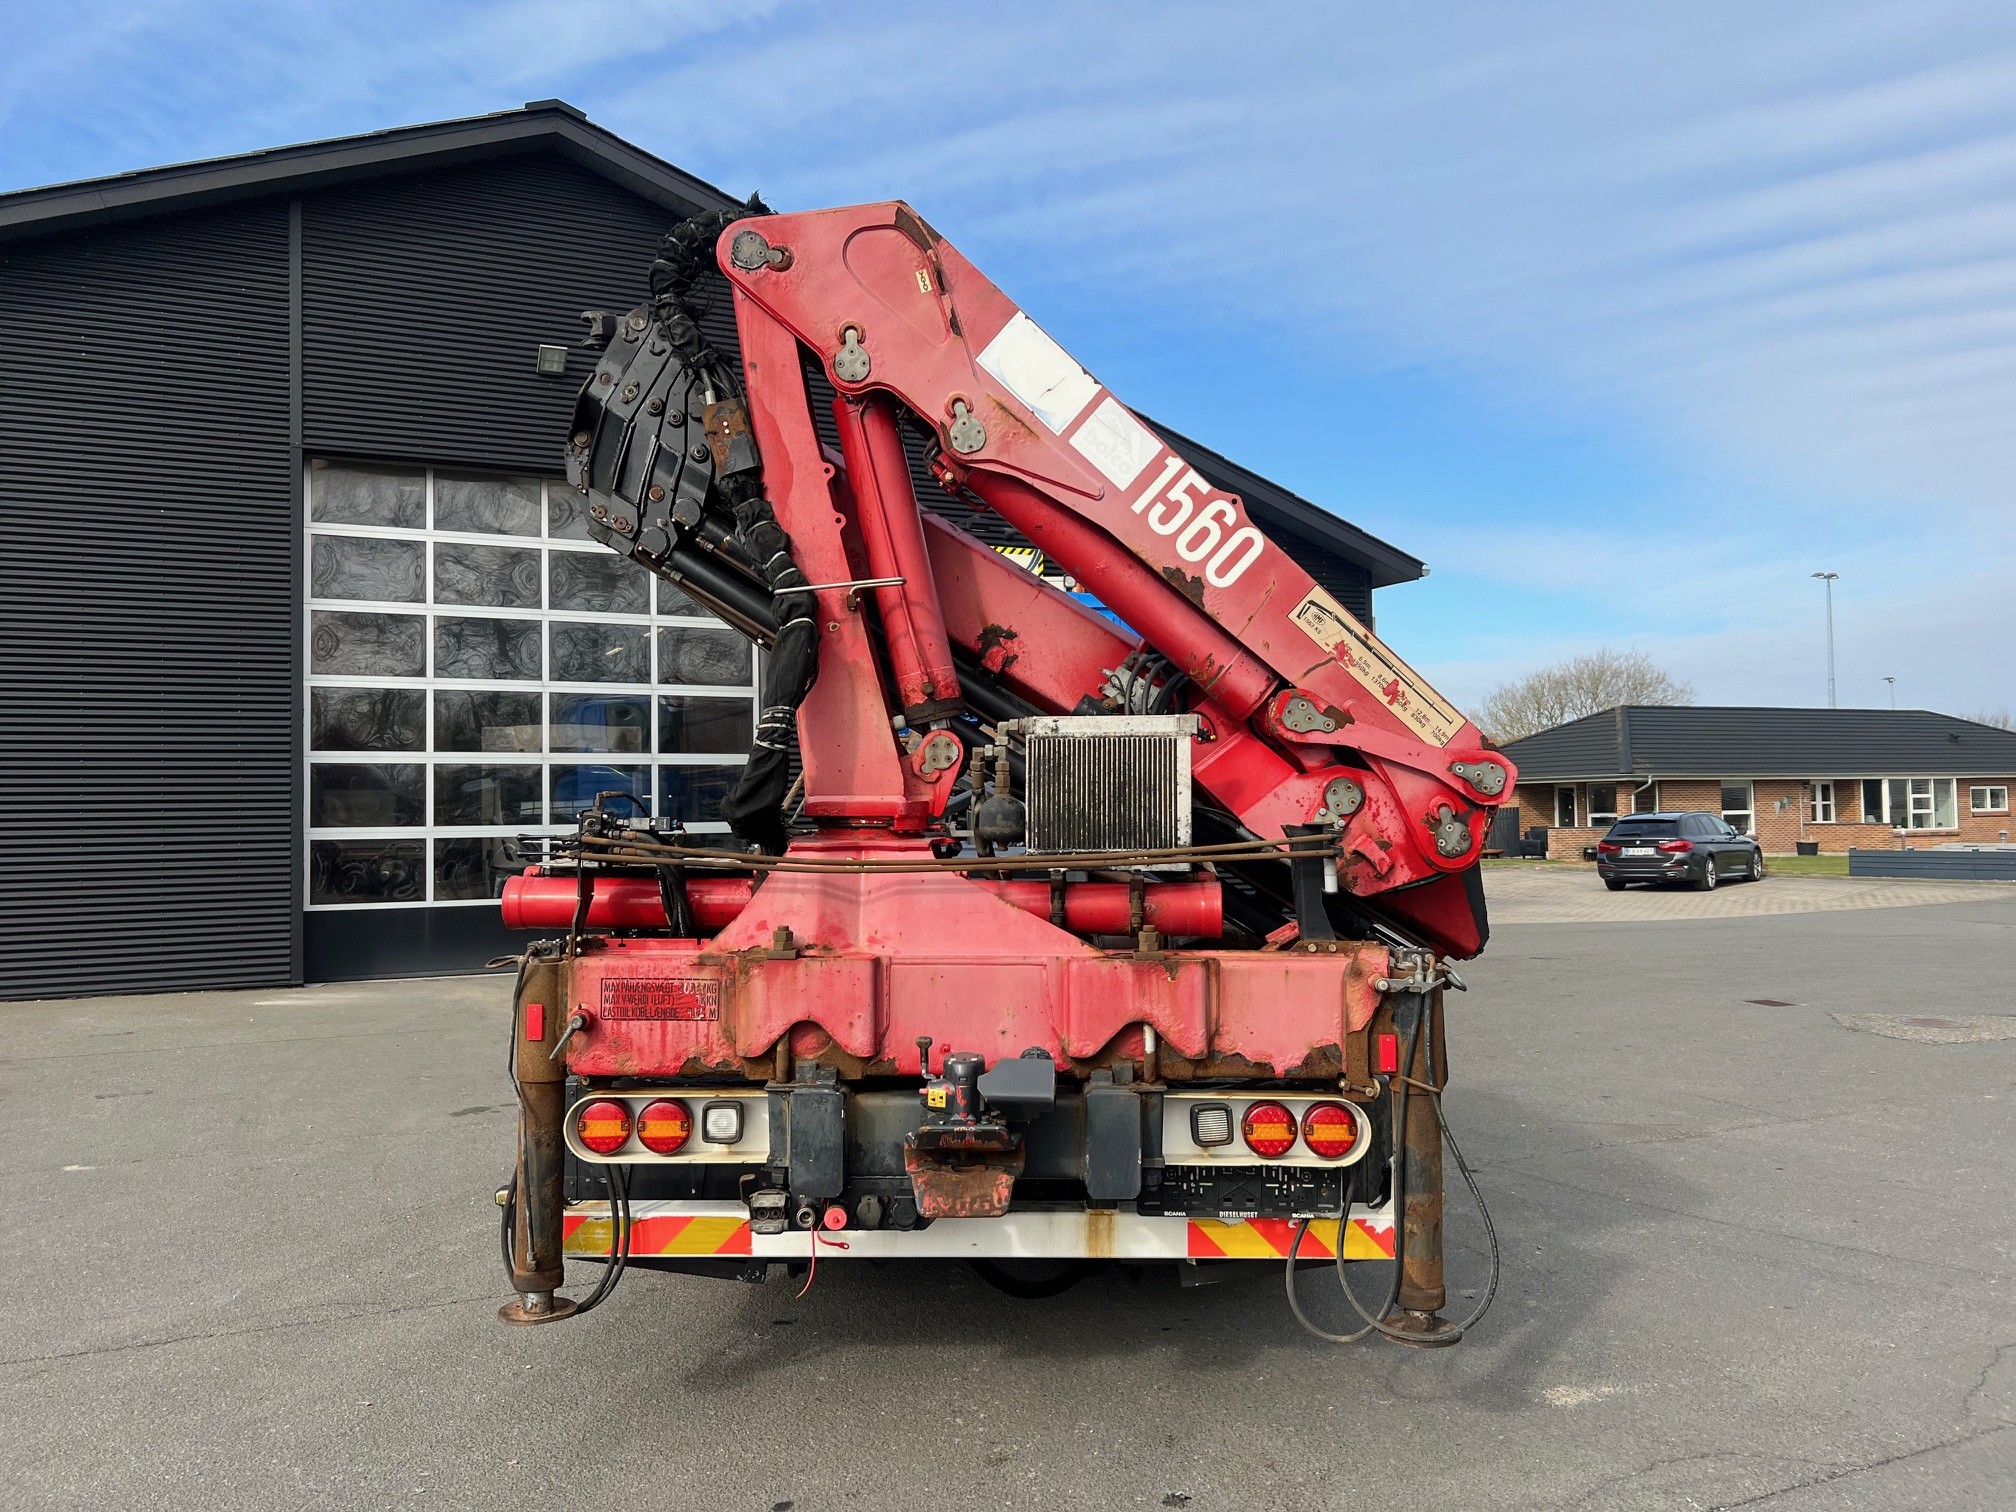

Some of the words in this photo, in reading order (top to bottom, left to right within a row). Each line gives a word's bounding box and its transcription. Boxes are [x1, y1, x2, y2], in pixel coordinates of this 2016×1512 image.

[1130, 455, 1264, 588] 1560
[1313, 613, 1325, 625] HMF
[603, 982, 620, 993] MAX
[706, 983, 717, 993] KG
[603, 994, 620, 1005] MAX
[651, 994, 675, 1006] (LUFT)
[706, 994, 717, 1005] KN
[603, 1006, 630, 1018] LASTBIL
[708, 1008, 716, 1018] M
